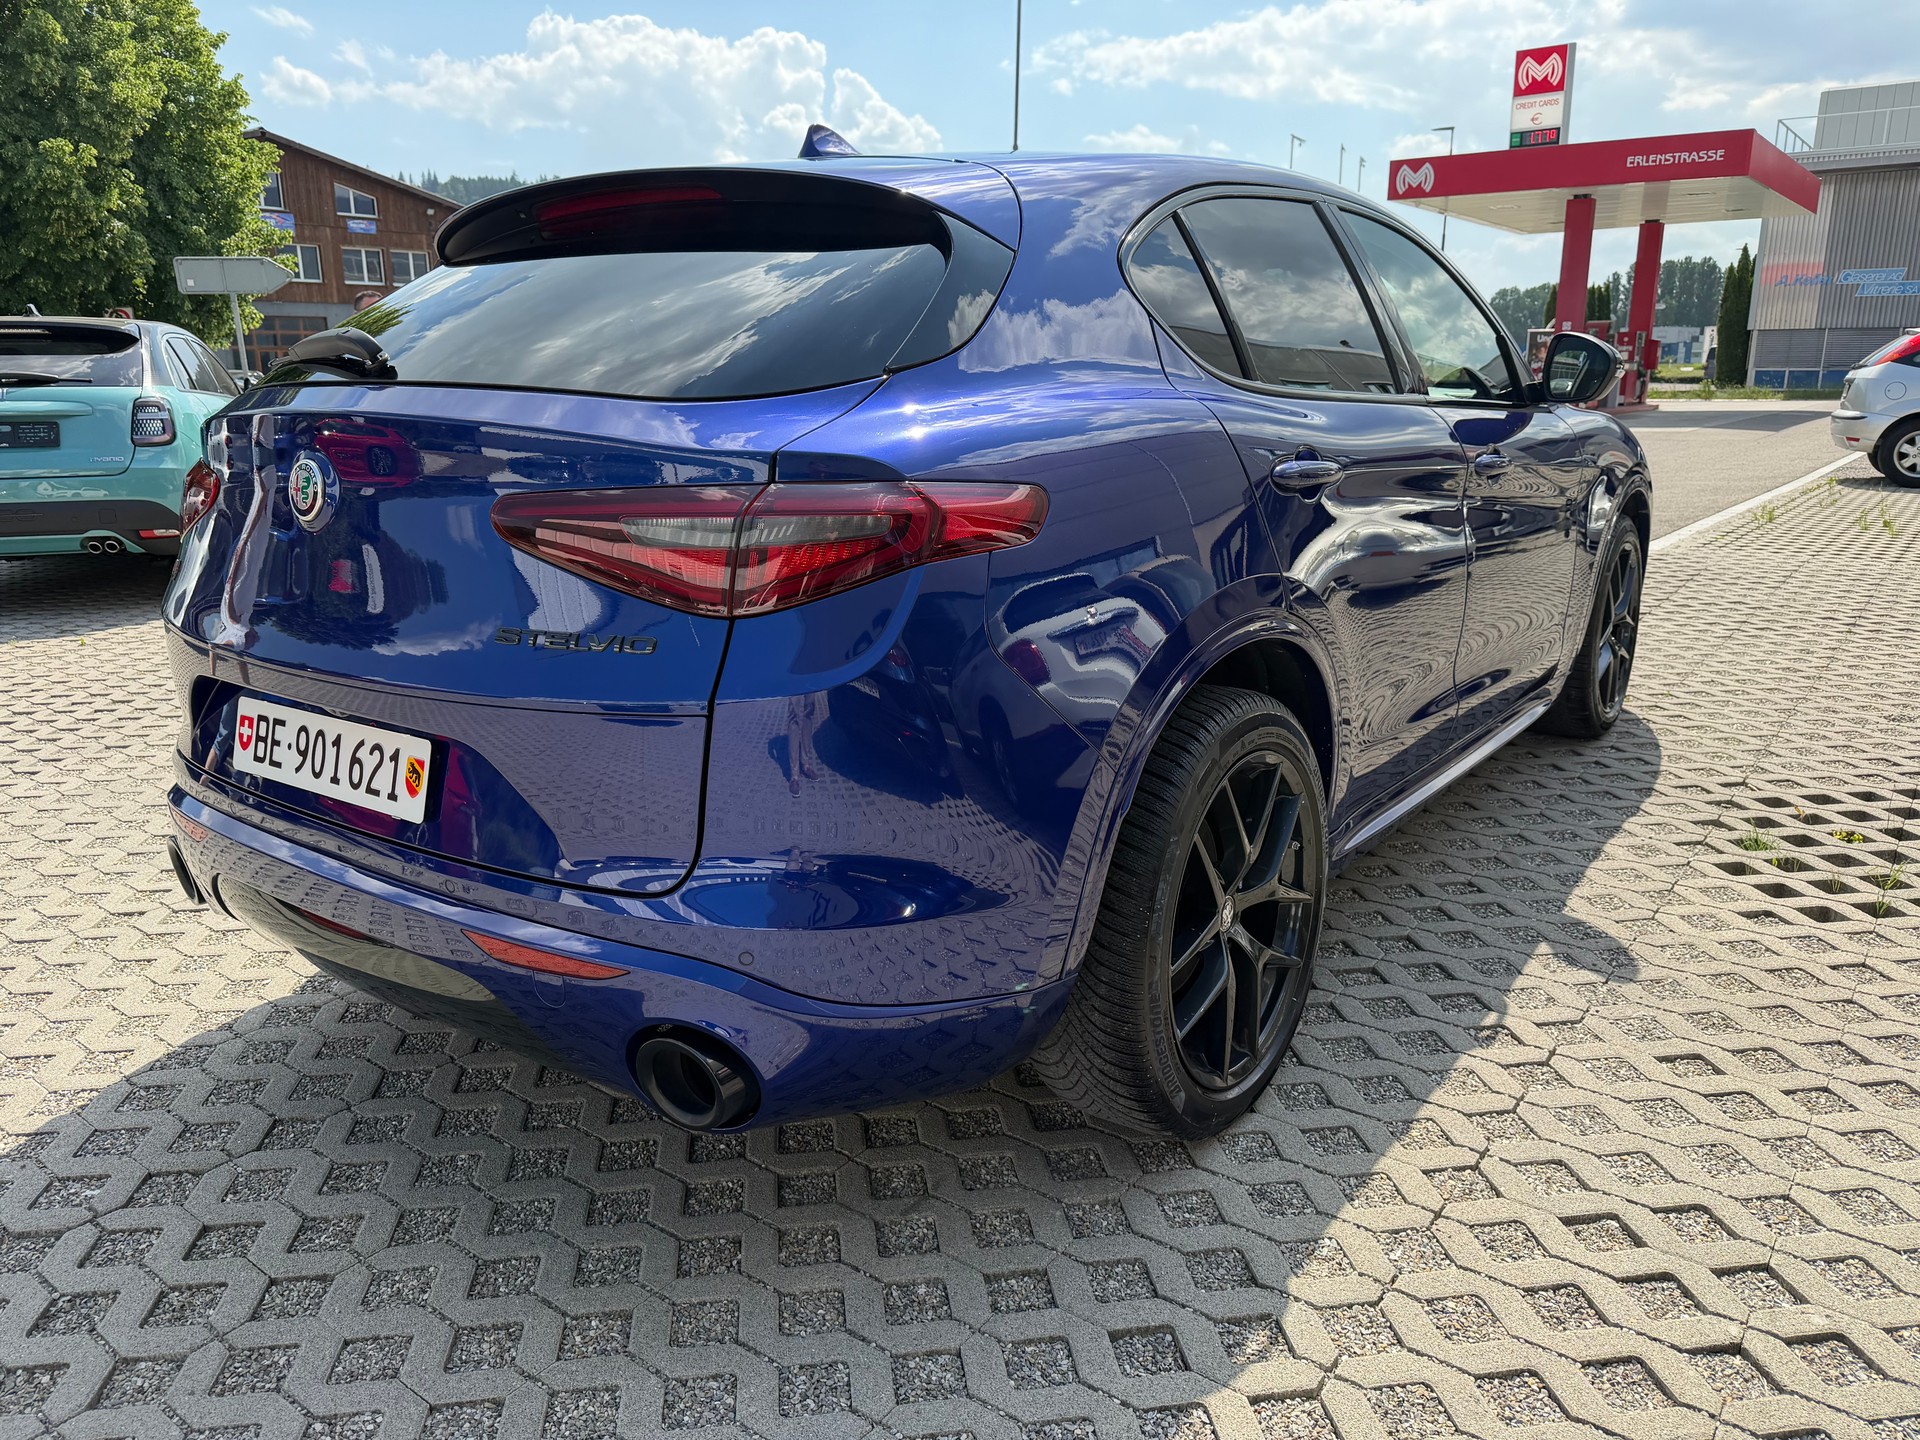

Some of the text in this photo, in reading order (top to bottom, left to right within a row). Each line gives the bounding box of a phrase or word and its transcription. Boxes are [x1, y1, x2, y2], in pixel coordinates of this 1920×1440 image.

[1515, 98, 1560, 110] CREDIT CARDS
[1626, 149, 1725, 168] ERLENSTRASSE
[494, 627, 658, 655] STELVIO
